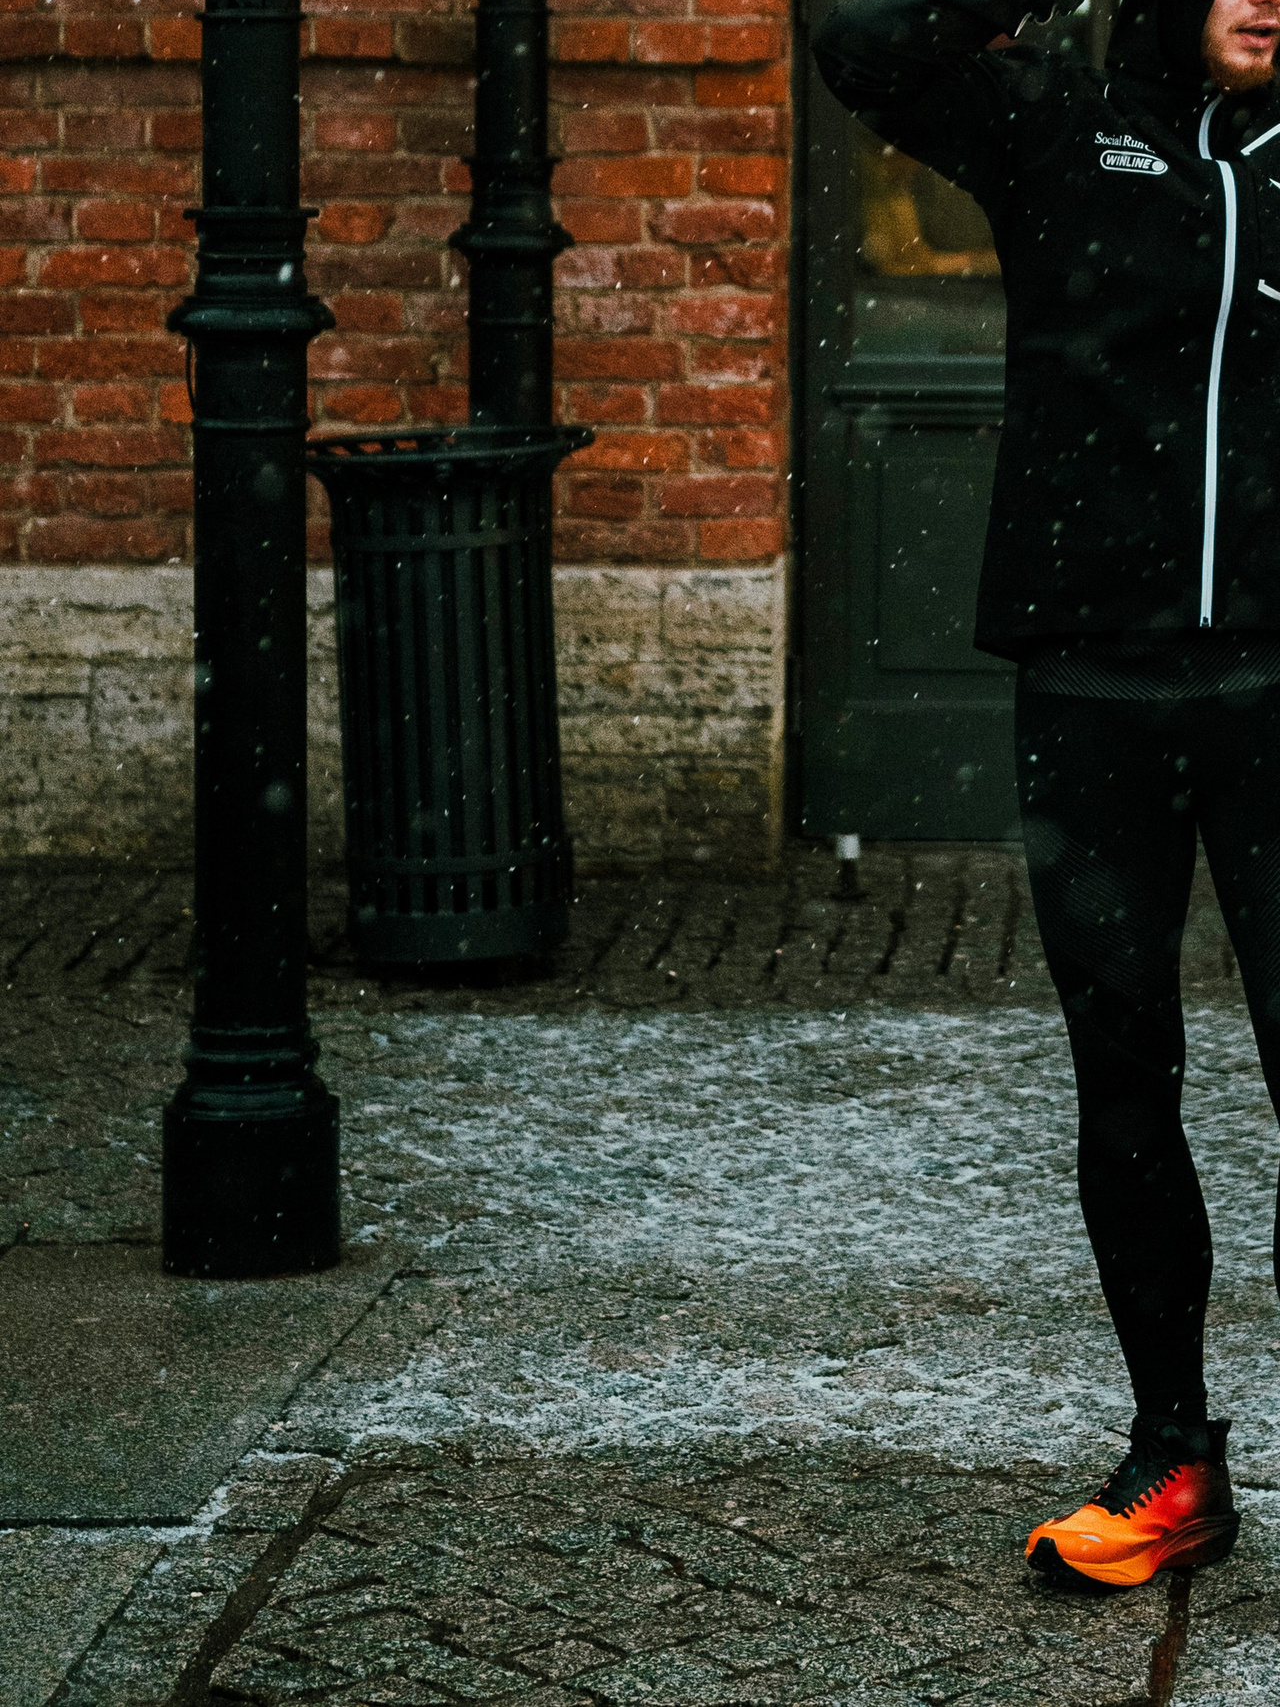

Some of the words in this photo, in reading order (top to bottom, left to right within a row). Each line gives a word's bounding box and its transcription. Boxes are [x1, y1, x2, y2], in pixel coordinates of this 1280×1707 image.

[1094, 131, 1122, 146] Social
[1122, 134, 1145, 150] Run
[1105, 154, 1153, 169] WINLINE
